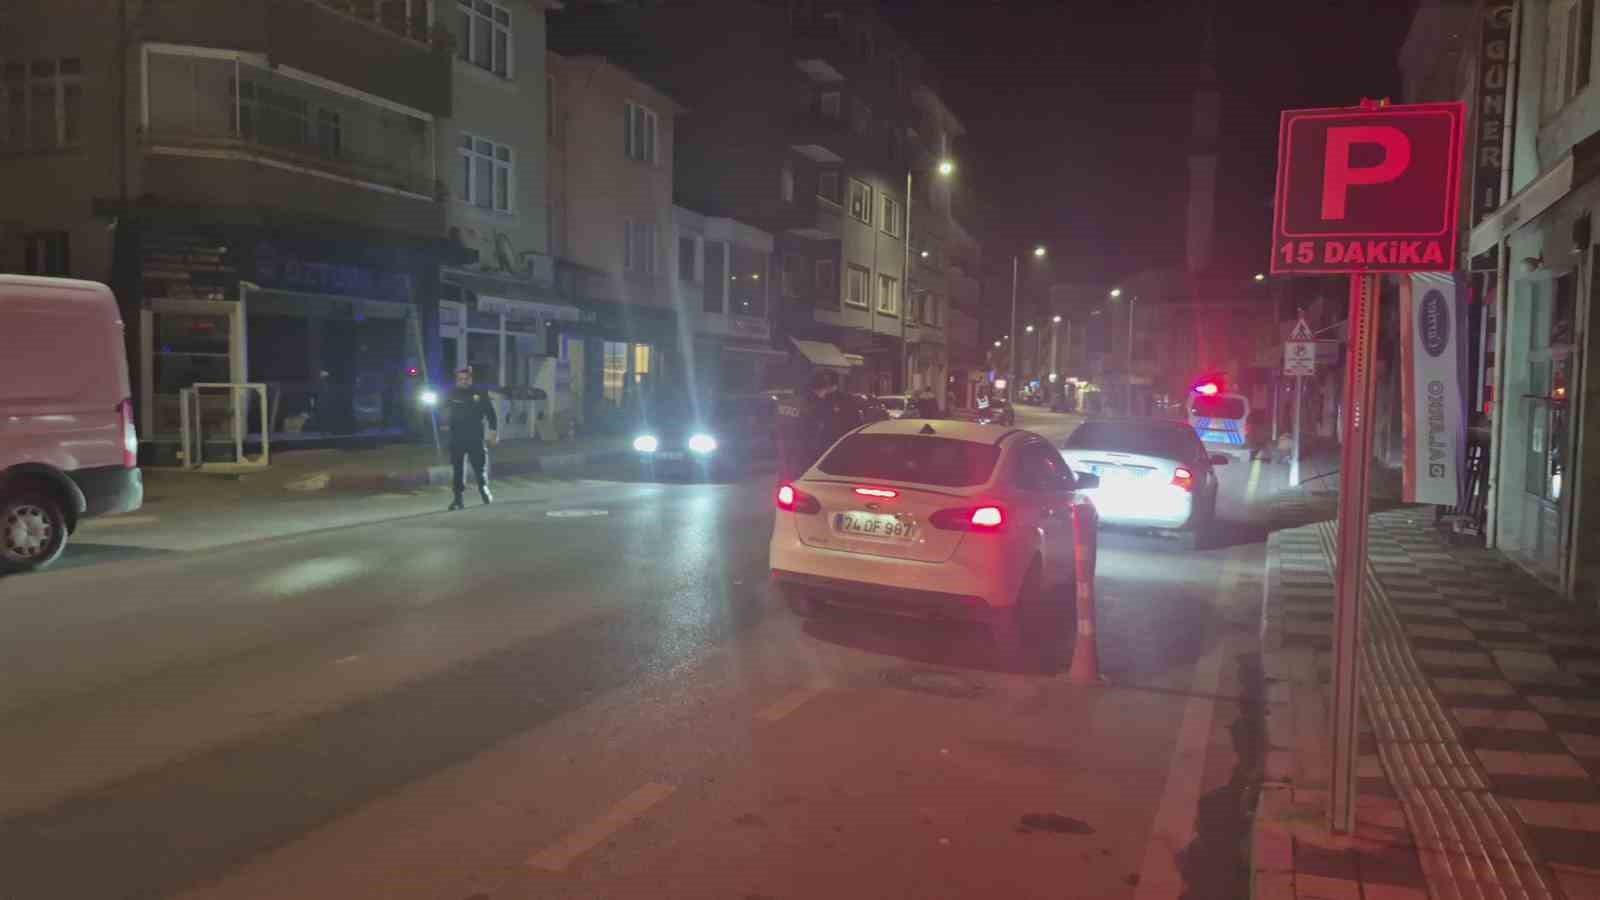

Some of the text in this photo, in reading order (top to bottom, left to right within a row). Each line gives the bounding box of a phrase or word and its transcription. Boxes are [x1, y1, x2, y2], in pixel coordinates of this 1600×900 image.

[1321, 126, 1411, 220] P
[1281, 242, 1315, 264] 15
[845, 516, 860, 530] 74
